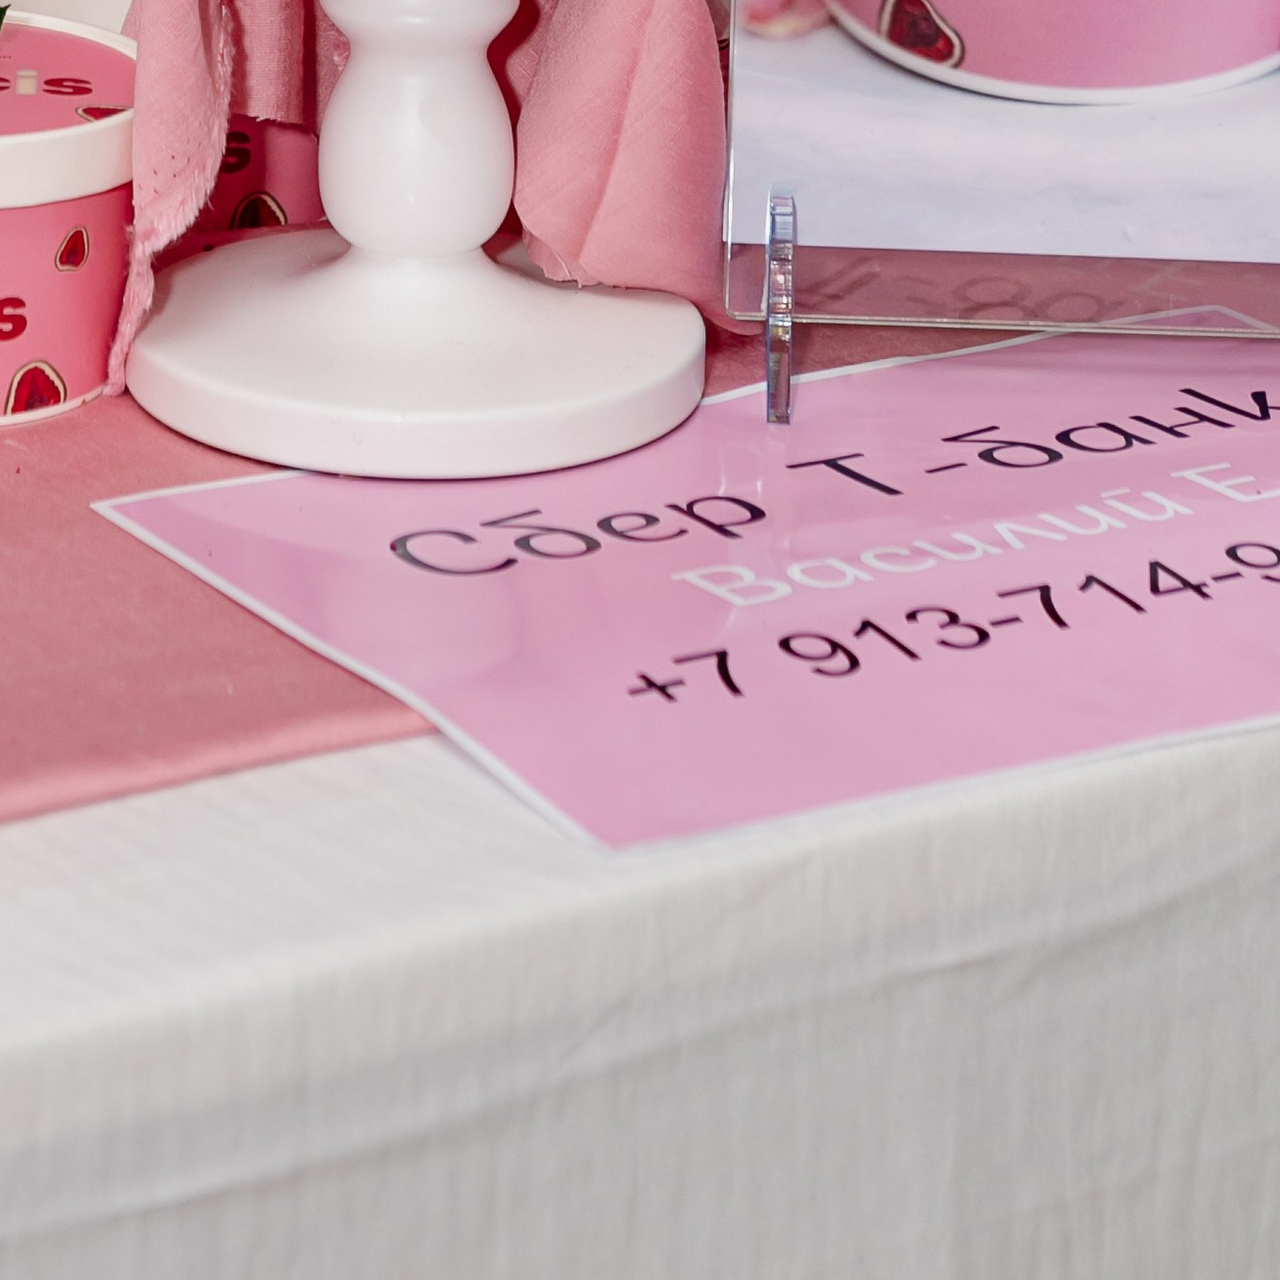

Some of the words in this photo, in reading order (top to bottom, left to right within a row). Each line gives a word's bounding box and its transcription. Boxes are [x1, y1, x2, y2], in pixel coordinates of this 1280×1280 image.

[389, 495, 767, 577] Сбер
[670, 486, 1195, 608] Василий
[627, 648, 745, 704] +7
